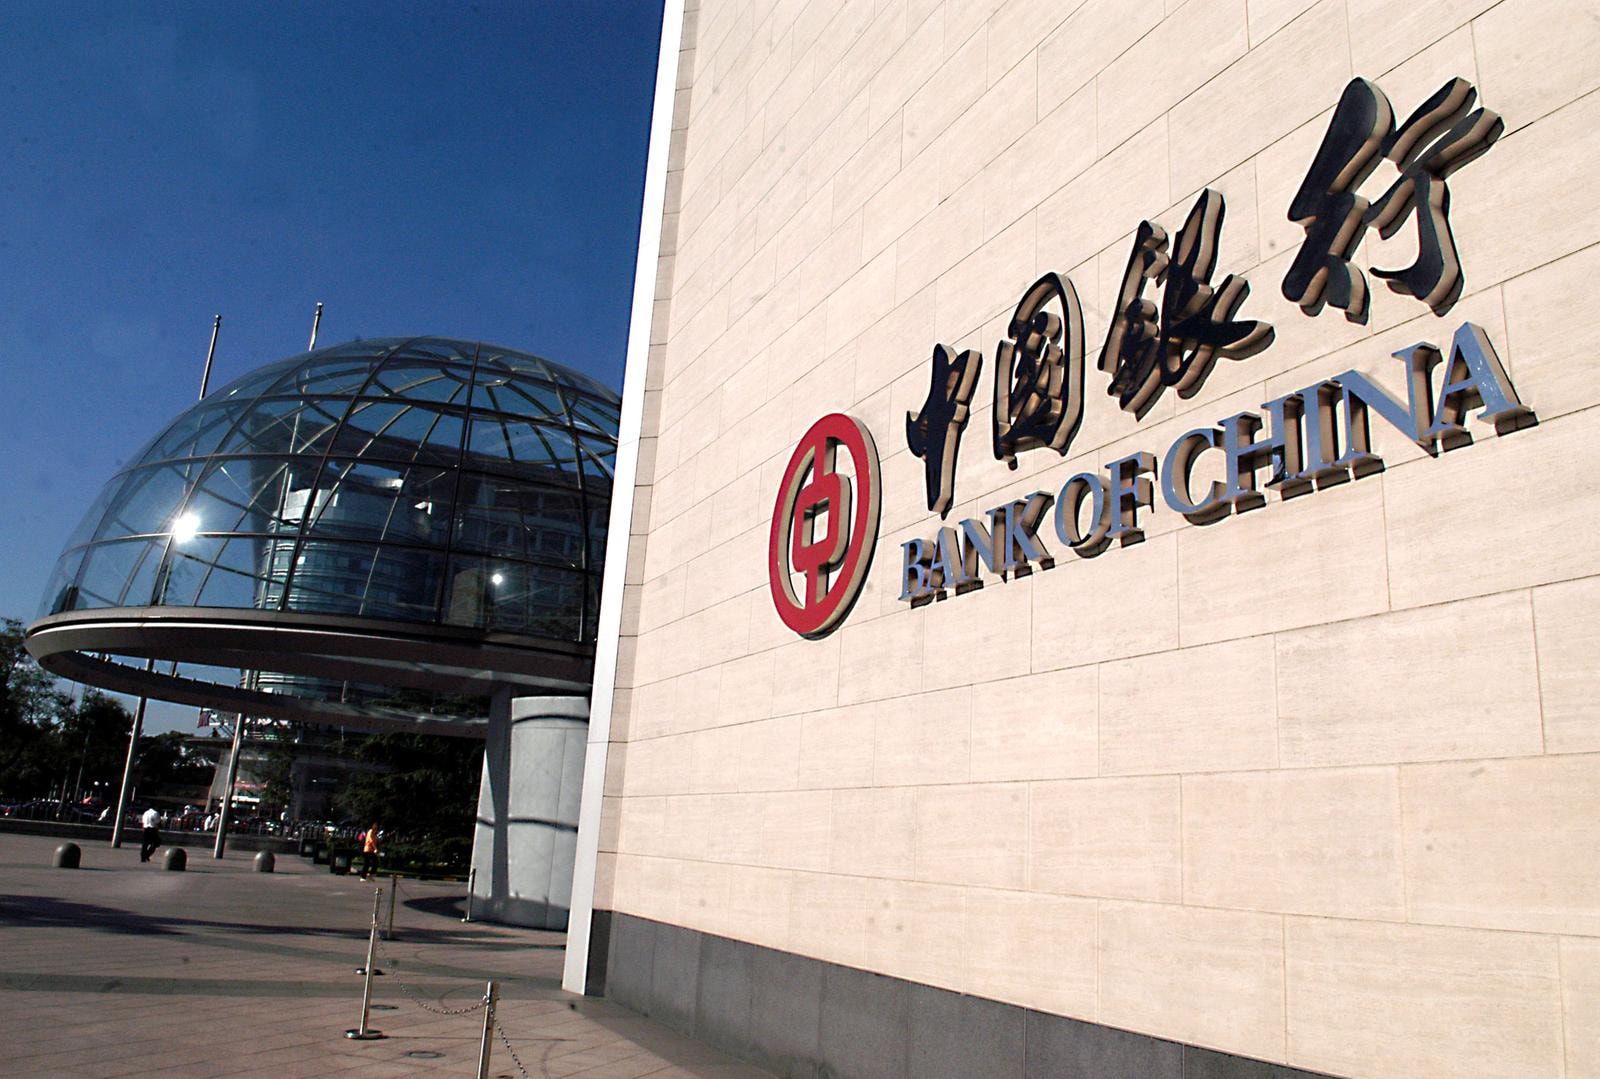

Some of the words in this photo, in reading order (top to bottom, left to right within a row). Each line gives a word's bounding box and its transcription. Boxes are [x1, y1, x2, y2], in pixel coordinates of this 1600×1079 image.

[899, 491, 1055, 608] BANK
[1055, 452, 1157, 559] OF
[1161, 322, 1538, 525] CHINA
